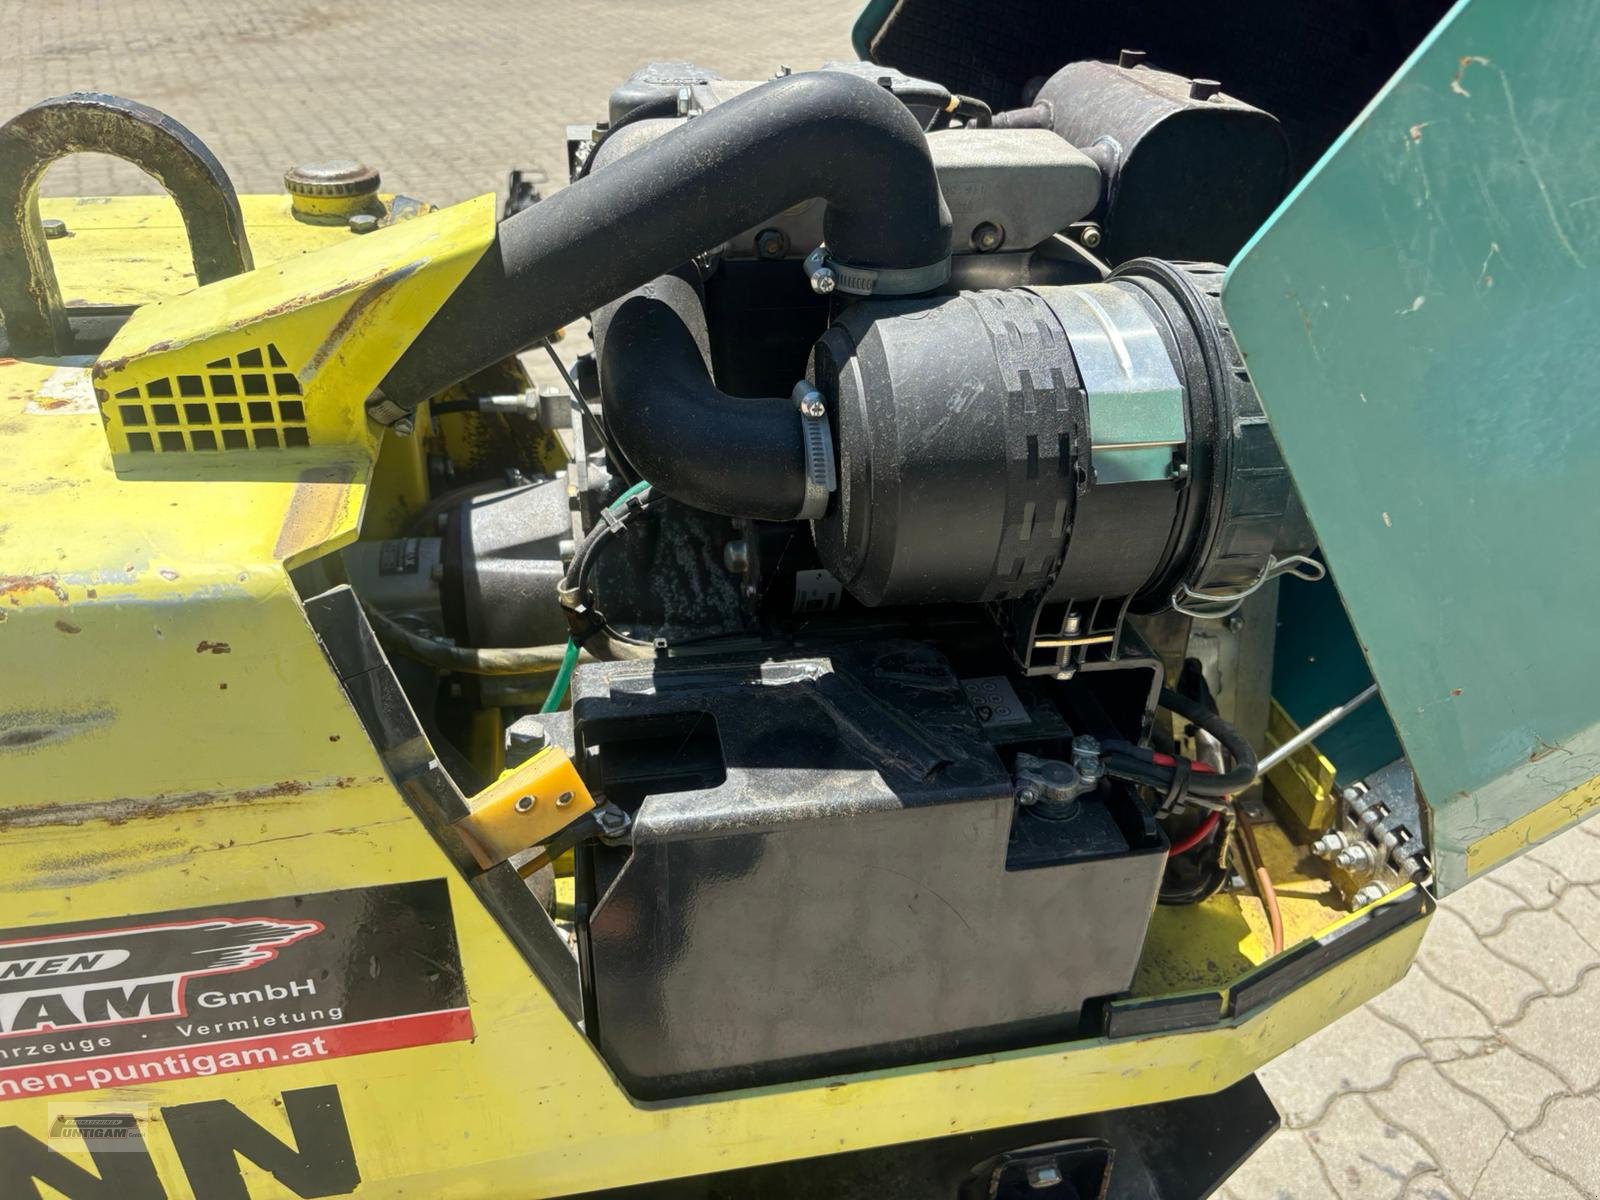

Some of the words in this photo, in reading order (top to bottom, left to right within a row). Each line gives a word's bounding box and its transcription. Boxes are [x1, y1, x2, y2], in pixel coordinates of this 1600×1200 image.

[1, 953, 104, 979] NEN
[0, 980, 174, 1032] AM
[197, 978, 317, 1009] GmbH
[176, 1007, 343, 1038] Vermietung
